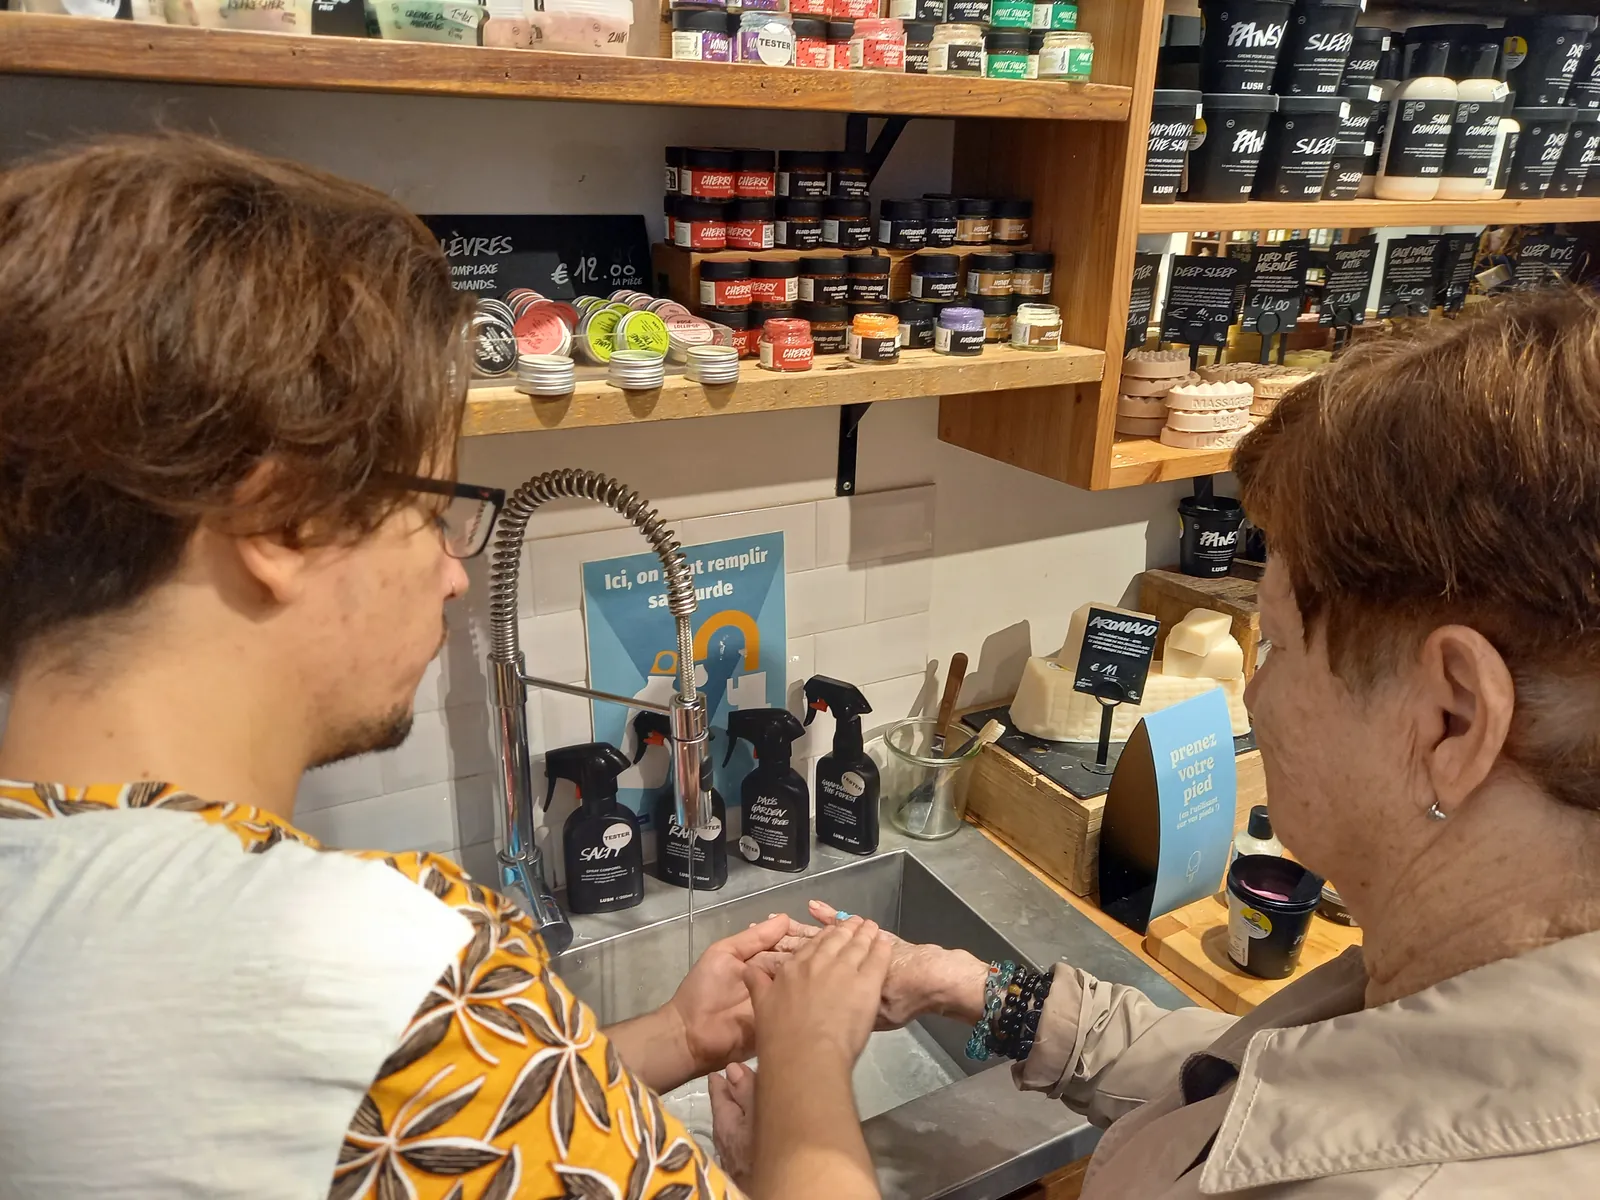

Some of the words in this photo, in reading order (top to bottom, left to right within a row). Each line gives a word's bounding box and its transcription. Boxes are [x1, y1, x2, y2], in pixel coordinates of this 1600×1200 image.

[1227, 20, 1288, 49] PANSY
[759, 37, 791, 50] TESTER
[1241, 82, 1264, 90] LUSH
[1147, 138, 1171, 151] THE
[1231, 129, 1267, 154] PAN
[1292, 137, 1336, 154] SLEEP
[701, 175, 733, 186] CHERRY
[737, 176, 771, 186] CHERRY
[700, 227, 726, 237] CHERR
[440, 231, 513, 257] LÈVRES
[1258, 251, 1282, 263] LORD
[1284, 251, 1298, 261] OF
[451, 263, 499, 276] OMPLEXE
[1174, 266, 1203, 278] DEEP
[1202, 266, 1237, 278] SLEEP
[1254, 260, 1299, 273] MISRULE
[452, 279, 497, 291] RMANDS.
[611, 277, 621, 286] LA
[621, 276, 643, 286] PIÈCE
[725, 284, 751, 296] CHERR
[783, 347, 813, 359] CHERRY
[1200, 531, 1238, 547] PANS
[604, 570, 632, 590] Ici,
[636, 569, 659, 585] on
[707, 546, 768, 572] remplir
[648, 594, 669, 609] sa
[1088, 616, 1158, 637] AROMACO
[1169, 732, 1217, 769] prenez
[1178, 756, 1215, 782] votre
[1183, 773, 1213, 806] pied
[751, 804, 787, 817] GARDEN
[749, 813, 771, 824] LEMON
[604, 831, 630, 841] TESTER
